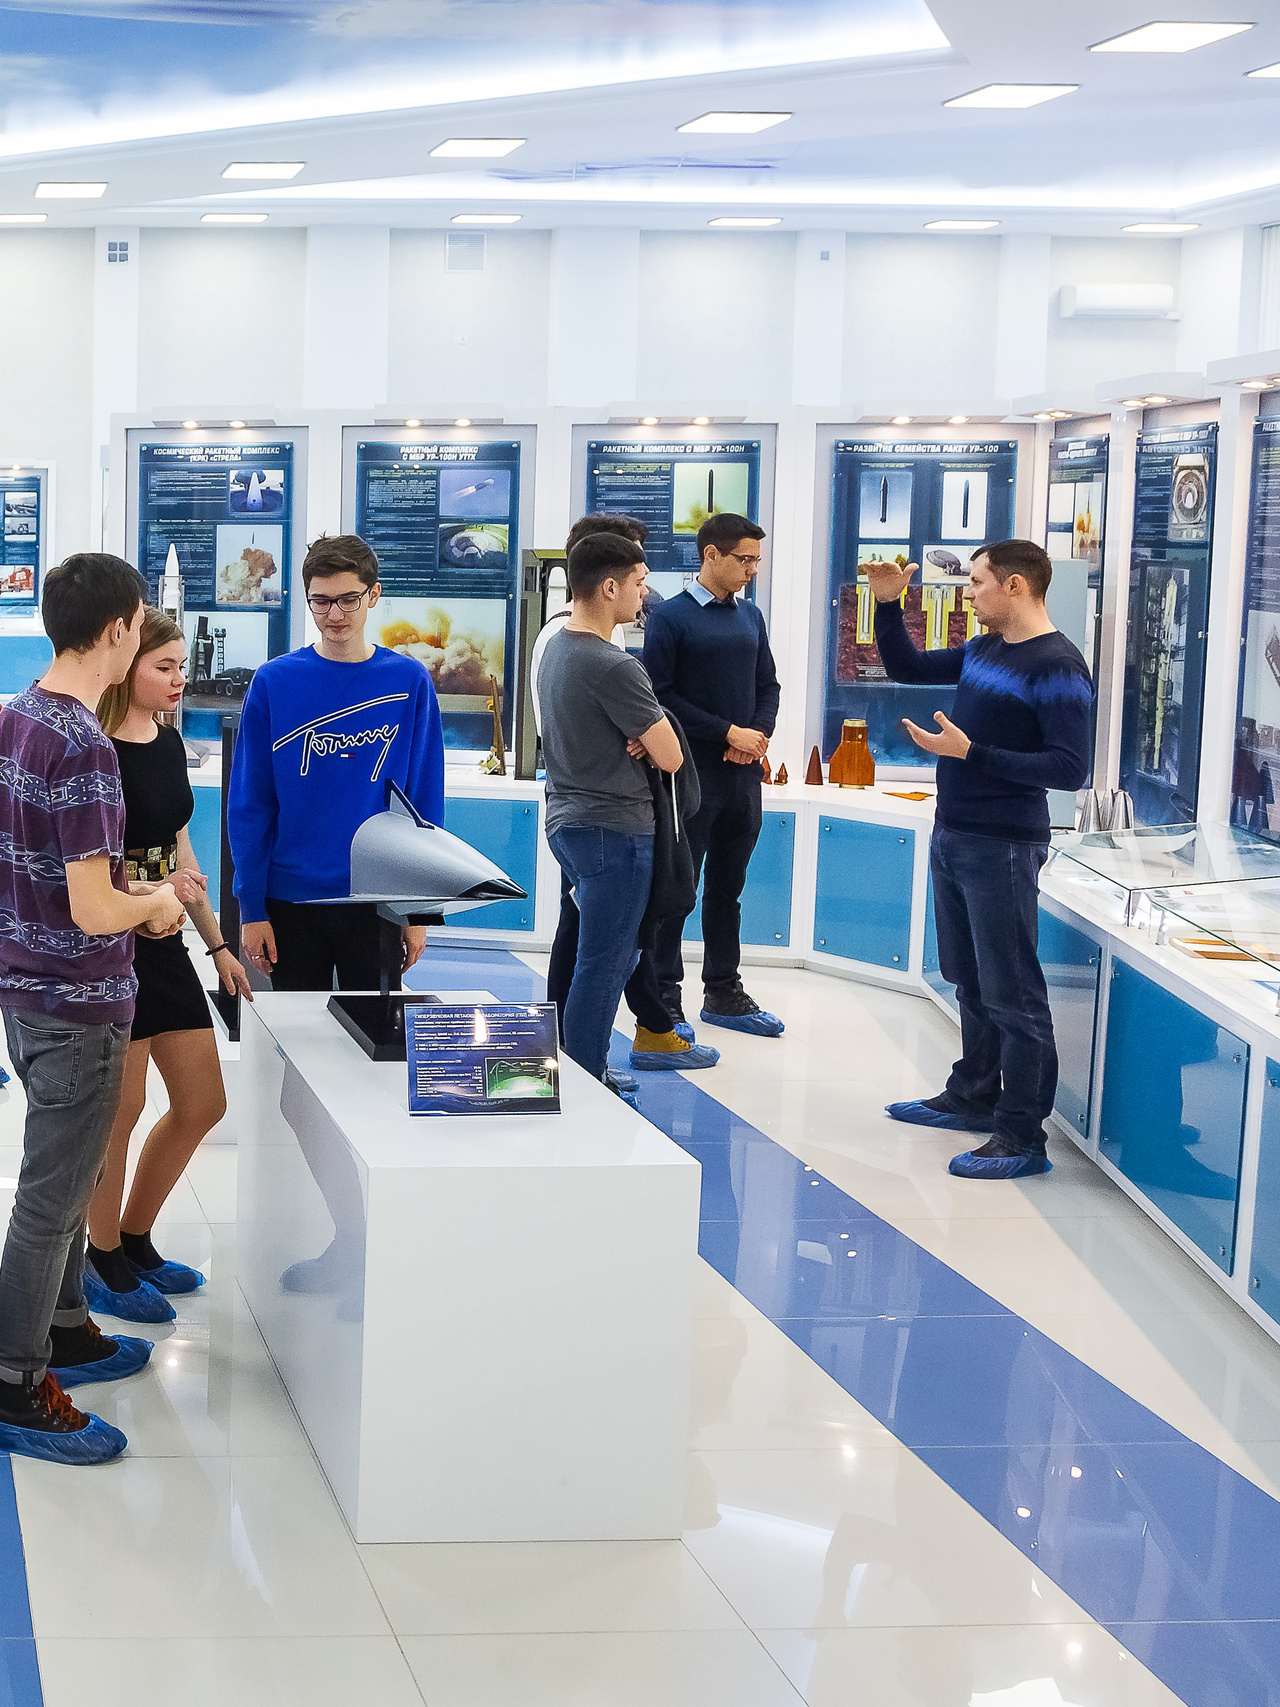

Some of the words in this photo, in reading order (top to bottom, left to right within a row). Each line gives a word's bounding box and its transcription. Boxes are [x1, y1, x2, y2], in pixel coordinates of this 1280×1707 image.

[153, 446, 204, 455] КОСМИЧЕСКИЙ
[204, 446, 241, 455] РАКЕТНЫЙ
[242, 446, 280, 454] КОМПЛЕКС
[400, 445, 438, 454] РАКЕТНЫЙ
[438, 446, 479, 454] КОМПЛЕКС
[603, 444, 642, 453] РАКЕТНЫЙ
[643, 445, 685, 453] КОМПЛЕКС
[711, 445, 745, 453] УР-100Н
[853, 443, 893, 453] РАЗВИТИЕ
[894, 443, 941, 453] СЕМЕЙСТВА
[942, 444, 968, 453] РАКЕТ
[968, 444, 999, 453] УР-100
[272, 692, 410, 782] Tommy
